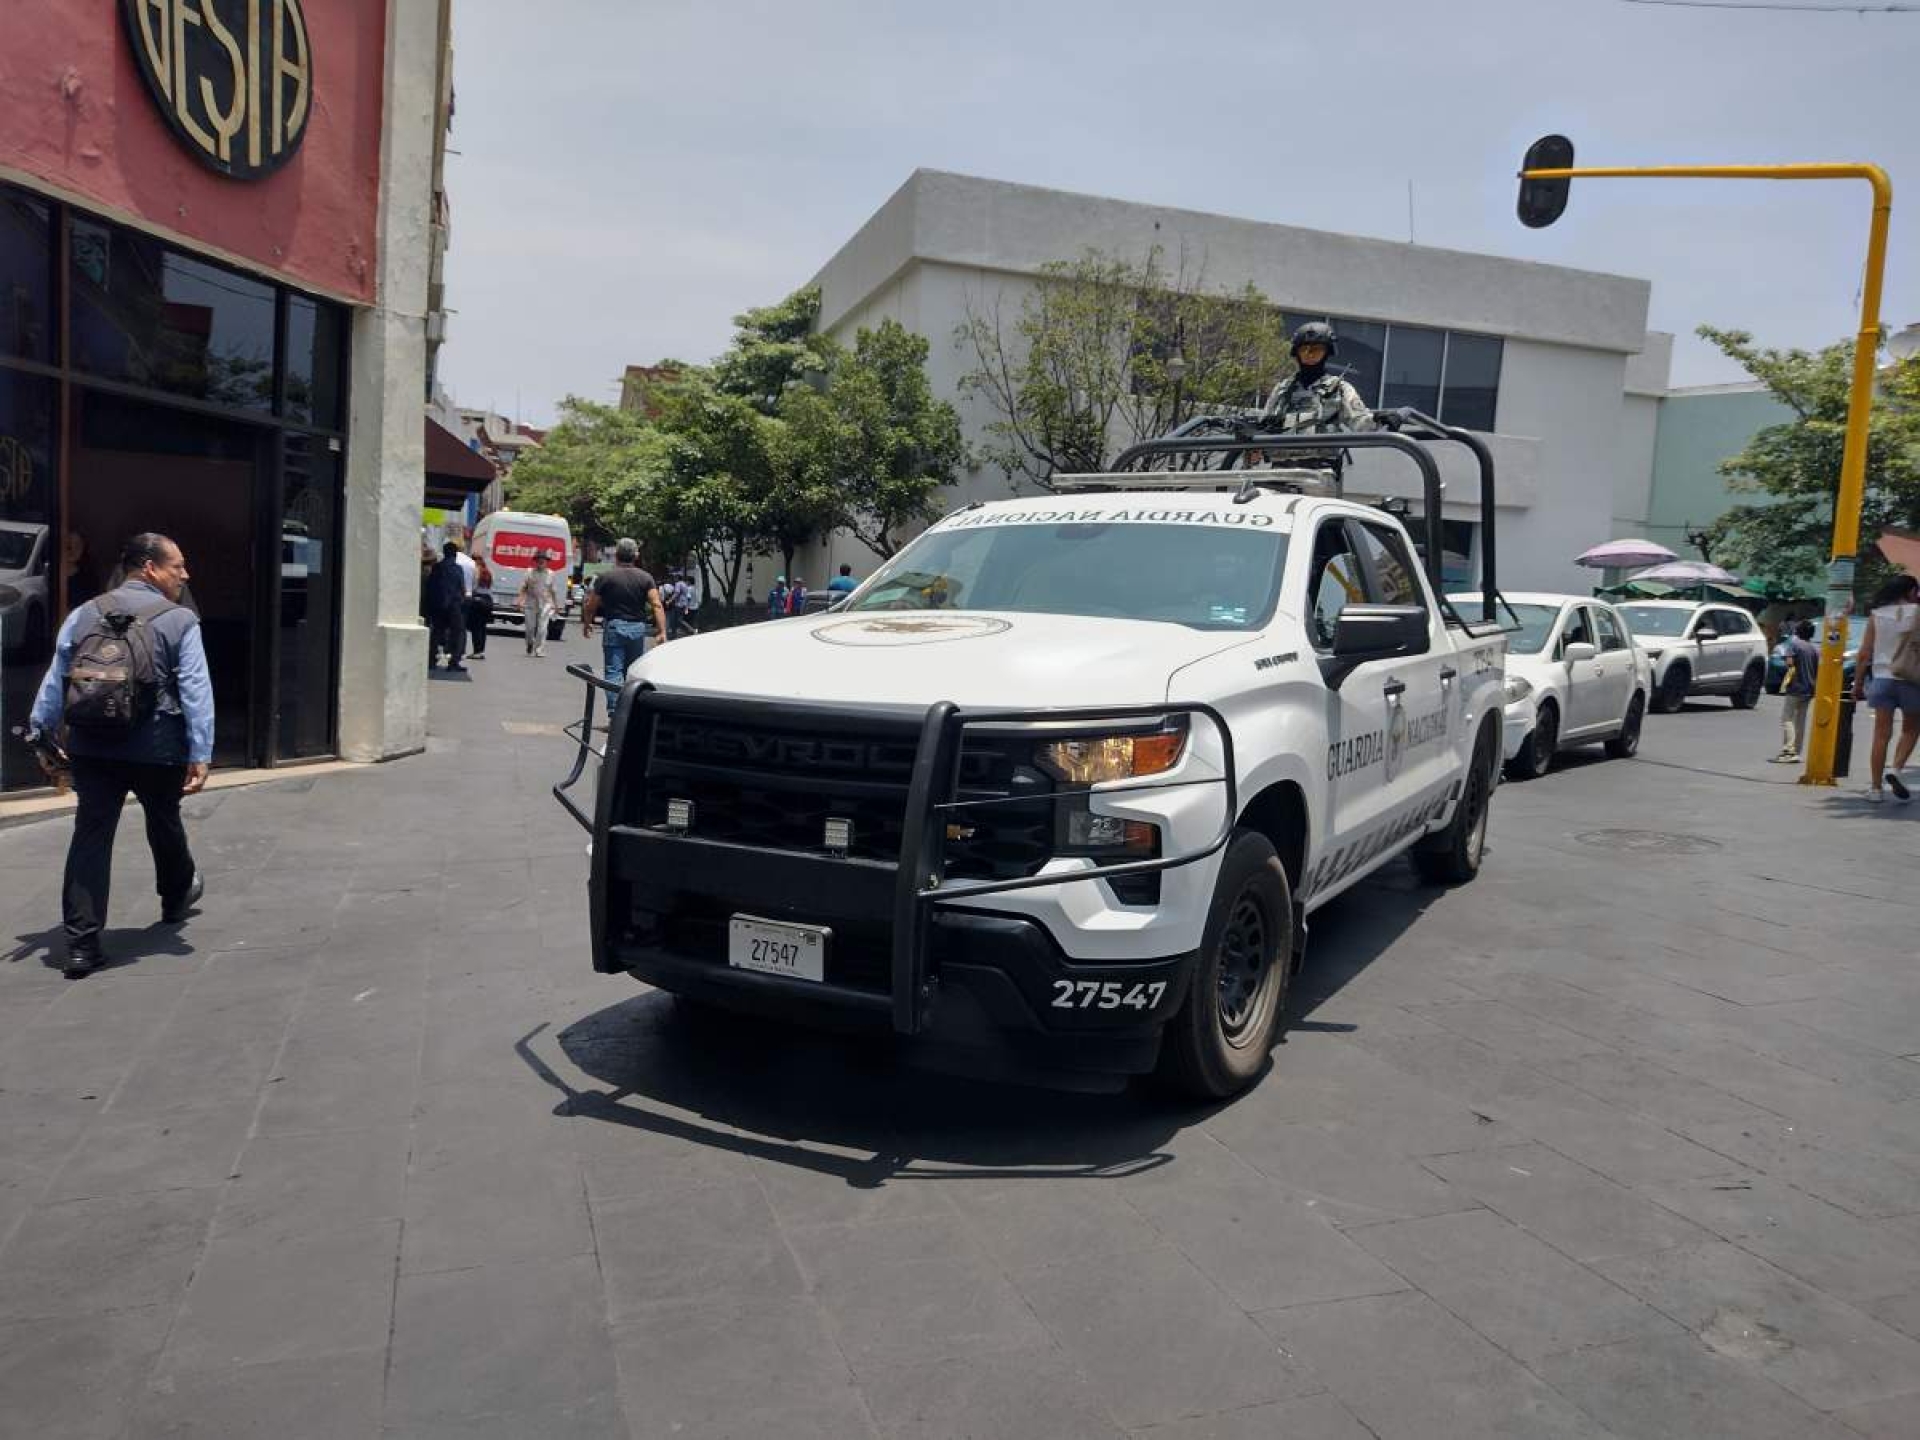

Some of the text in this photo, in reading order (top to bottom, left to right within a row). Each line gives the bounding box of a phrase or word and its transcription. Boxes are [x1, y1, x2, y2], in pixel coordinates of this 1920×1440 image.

[1327, 729, 1383, 781] GUARDIA
[751, 938, 799, 968] 27547
[1051, 980, 1167, 1010] 27547
